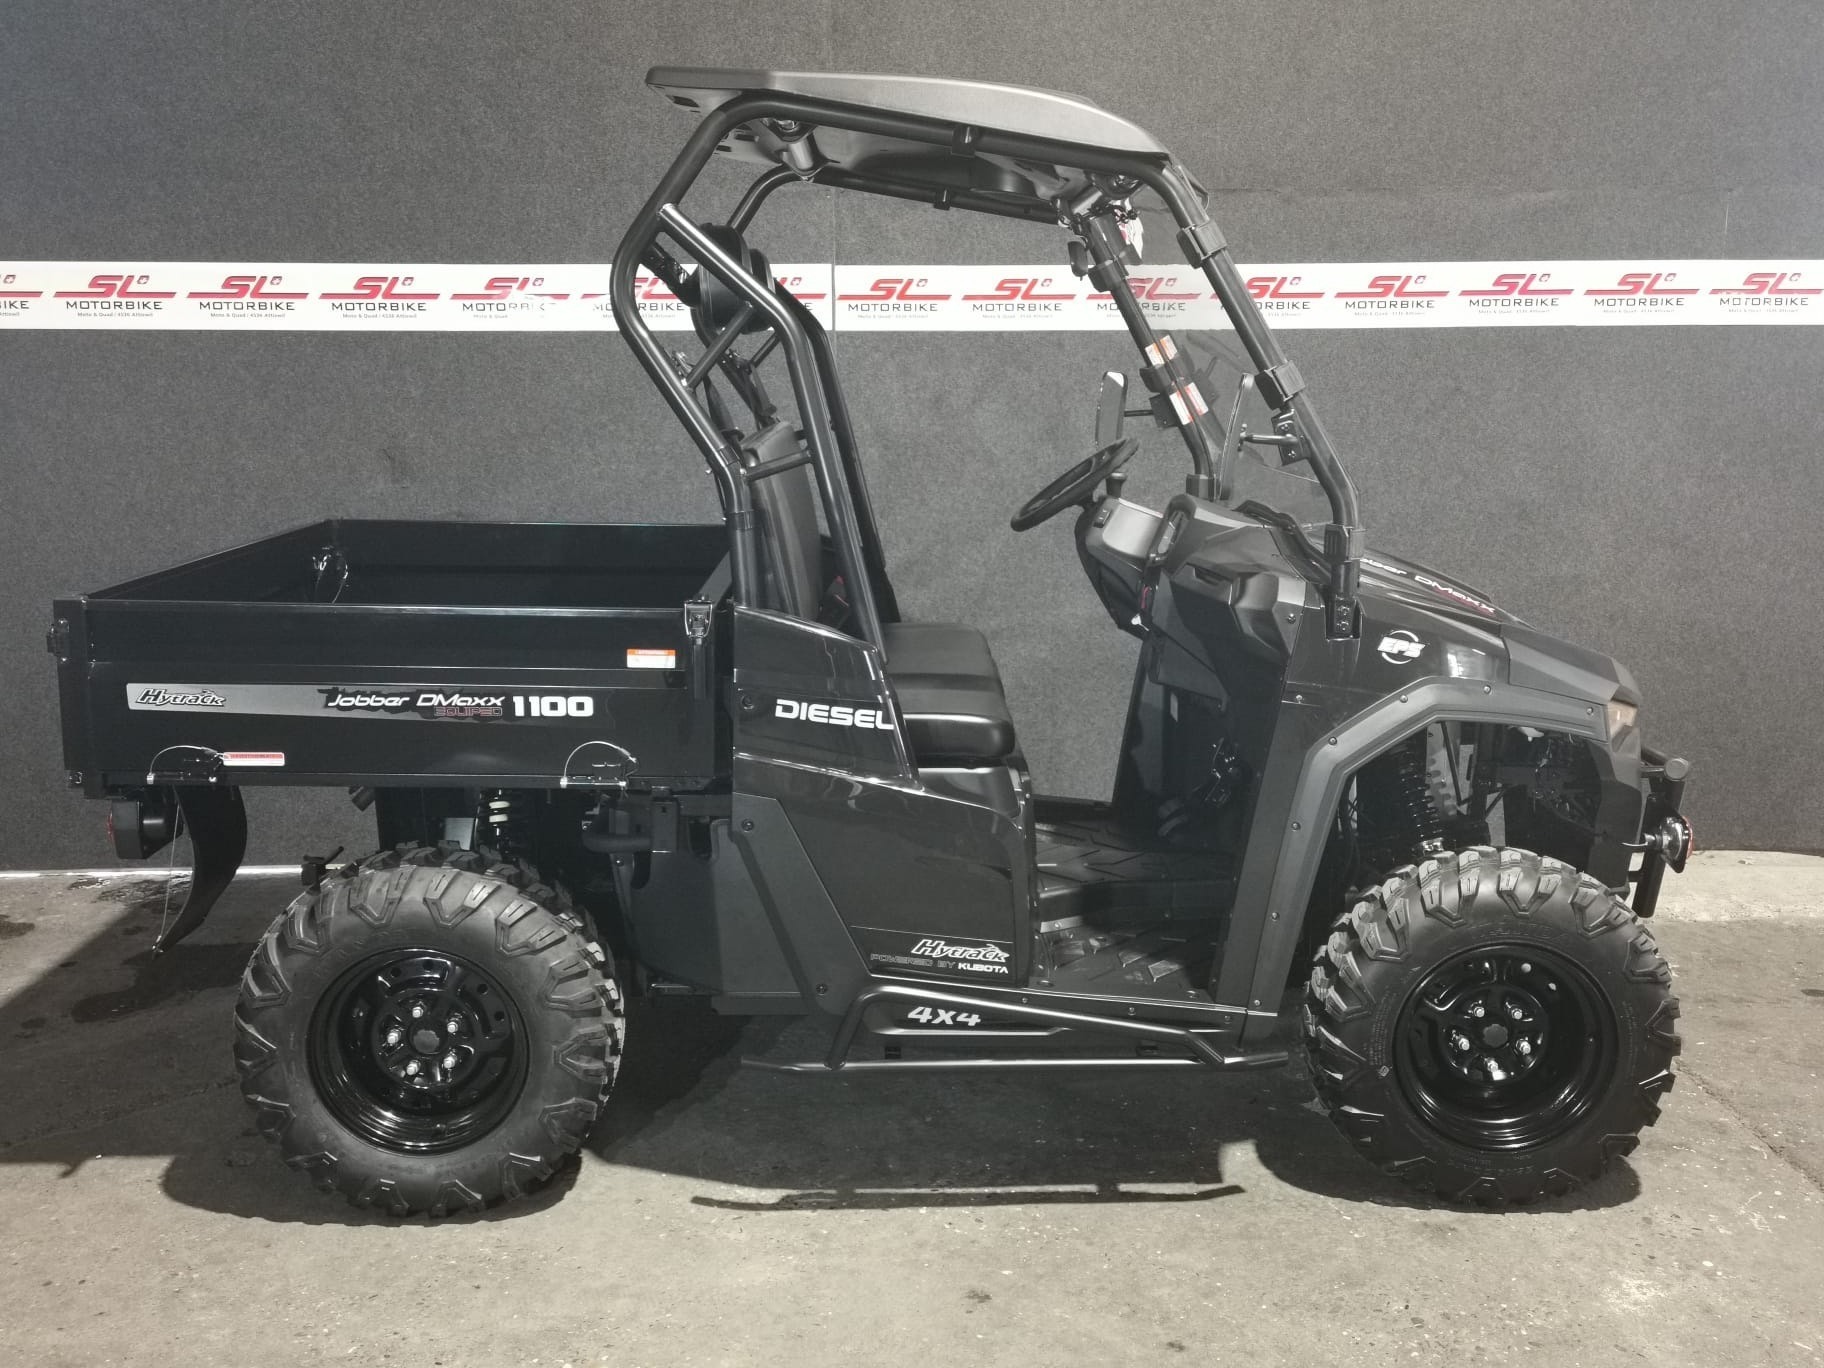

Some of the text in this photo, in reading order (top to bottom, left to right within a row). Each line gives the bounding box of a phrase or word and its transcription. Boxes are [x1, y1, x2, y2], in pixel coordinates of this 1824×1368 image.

[66, 300, 163, 310] MOTORBIKE
[199, 301, 296, 311] MOTORBIKE
[331, 302, 427, 311] MOTORBIKE
[1345, 300, 1435, 309] MOTORBIKE
[1469, 297, 1559, 307] MOTORBIKE
[1594, 297, 1685, 307] MOTORBIKE
[1719, 297, 1808, 306] MOTORBIKE
[848, 303, 938, 312] MOTORBIKE
[972, 302, 1063, 312] MOTORBIKE
[1415, 575, 1495, 613] DMaxx
[1377, 636, 1426, 658] EPS
[137, 688, 226, 707] Hytrack
[328, 693, 594, 717] Jobber DMaxx 1100
[434, 706, 503, 717] EQUIPED
[775, 698, 895, 730] DIESEL
[911, 938, 1010, 963] Hytrack
[870, 953, 1009, 974] POWERED BY KUBOTA
[907, 1006, 982, 1027] 4X4
